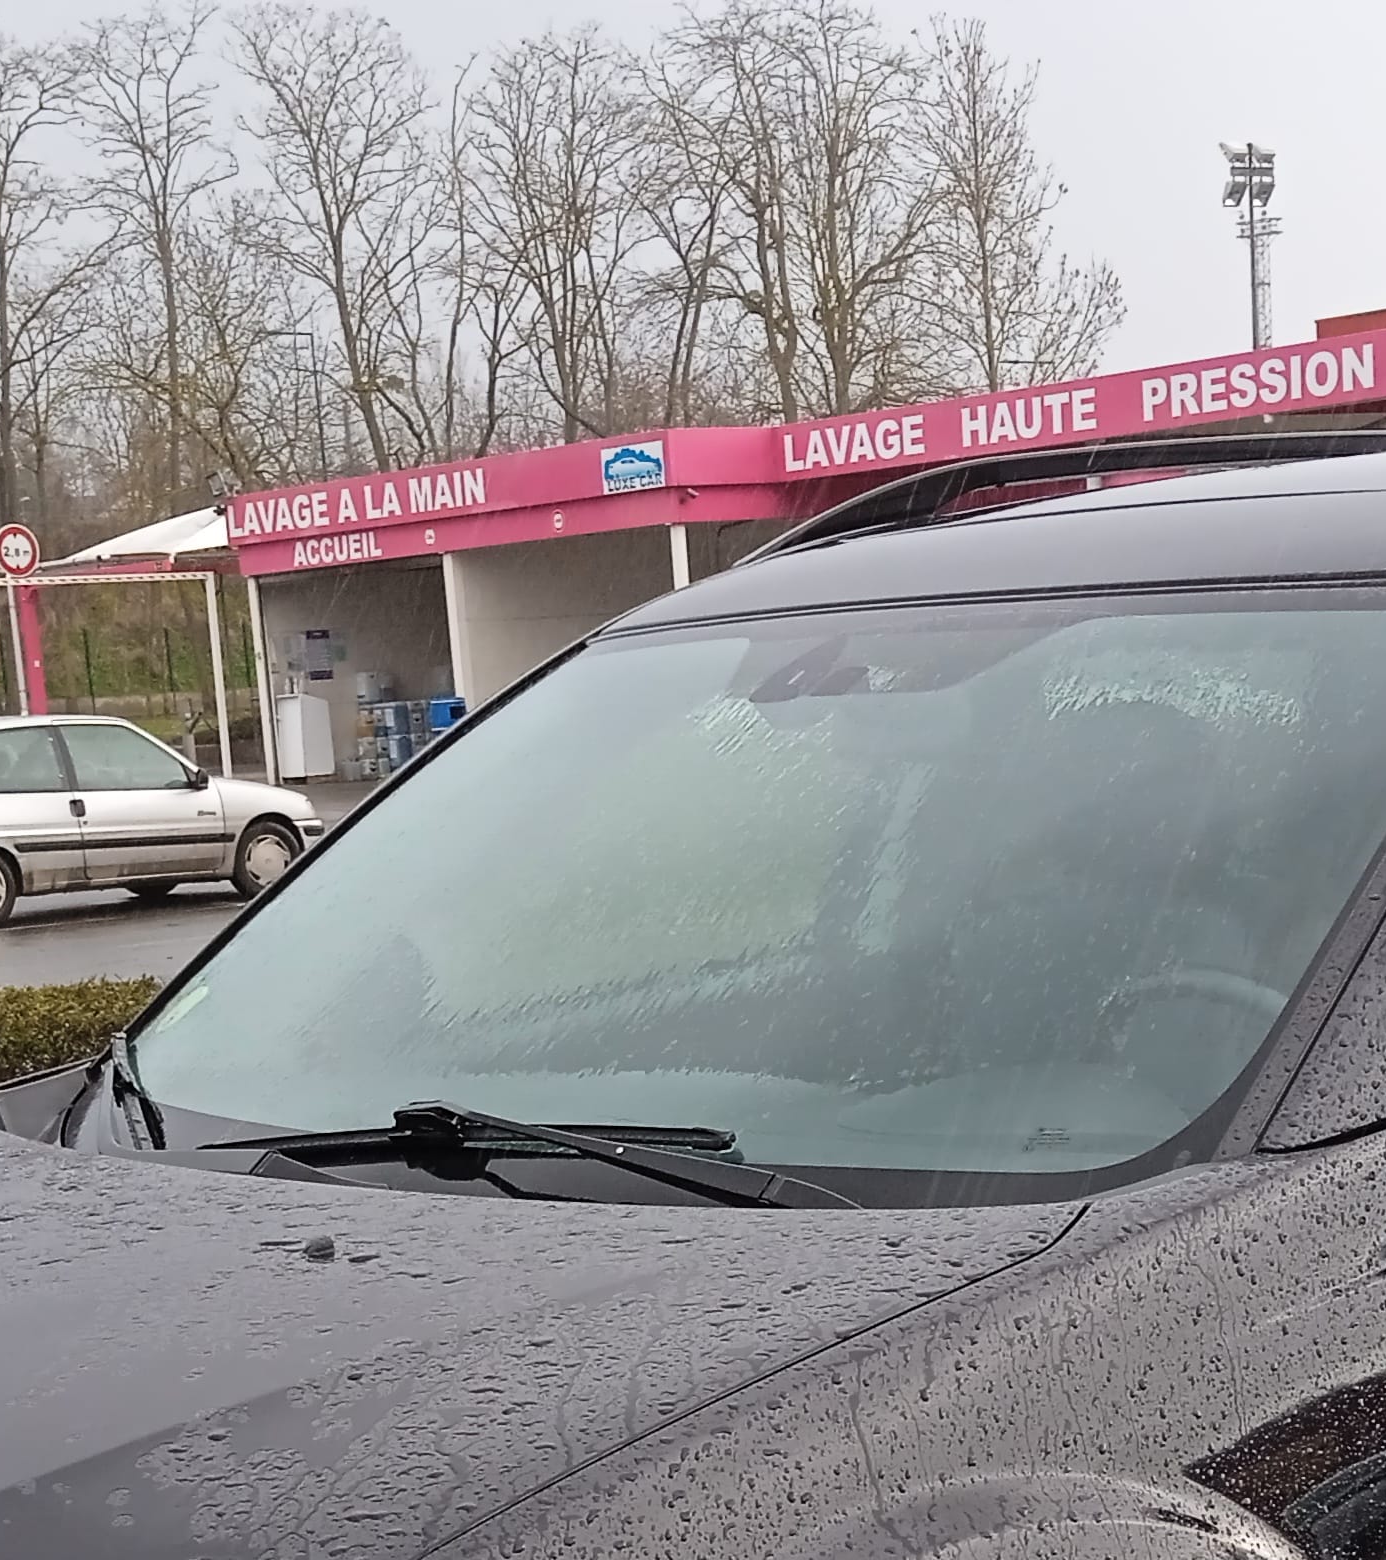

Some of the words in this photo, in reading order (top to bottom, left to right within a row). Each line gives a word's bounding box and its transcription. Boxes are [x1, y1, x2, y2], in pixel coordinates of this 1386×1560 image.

[784, 414, 926, 473] LAVAGE
[961, 387, 1098, 448] HAUTE
[1141, 343, 1375, 423] PRESSION
[227, 492, 330, 538] LAVAGE
[337, 487, 358, 525] A
[363, 480, 402, 521] LA
[409, 467, 486, 514] MAIN
[606, 475, 637, 492] LUXE
[639, 471, 663, 487] CAR
[293, 531, 383, 568] ACCUEIL
